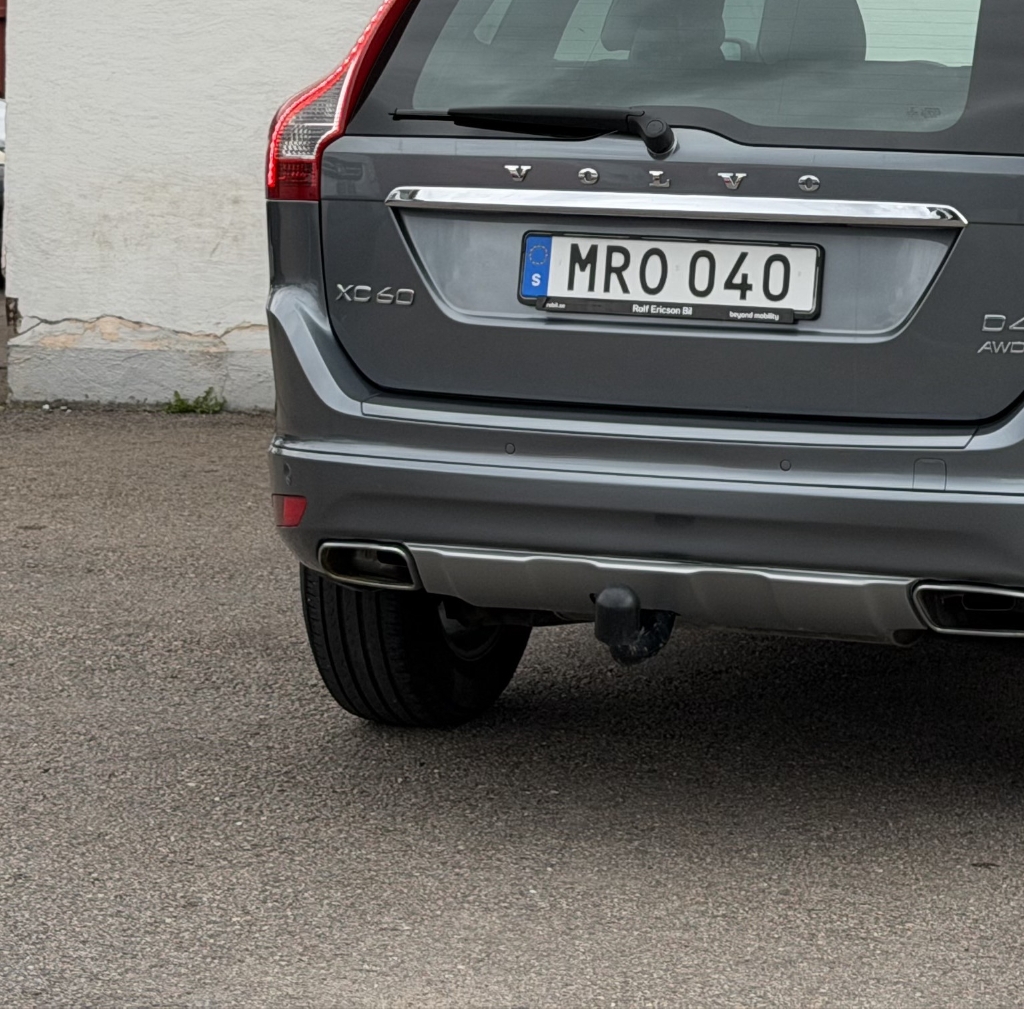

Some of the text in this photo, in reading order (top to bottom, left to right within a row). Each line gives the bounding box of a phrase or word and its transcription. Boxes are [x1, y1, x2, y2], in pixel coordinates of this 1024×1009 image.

[504, 164, 821, 192] VOLVO
[566, 242, 791, 302] MRO 040
[531, 273, 541, 287] S
[632, 303, 693, 316] Rolf Ericson Bil
[729, 310, 780, 322] beyond mobility
